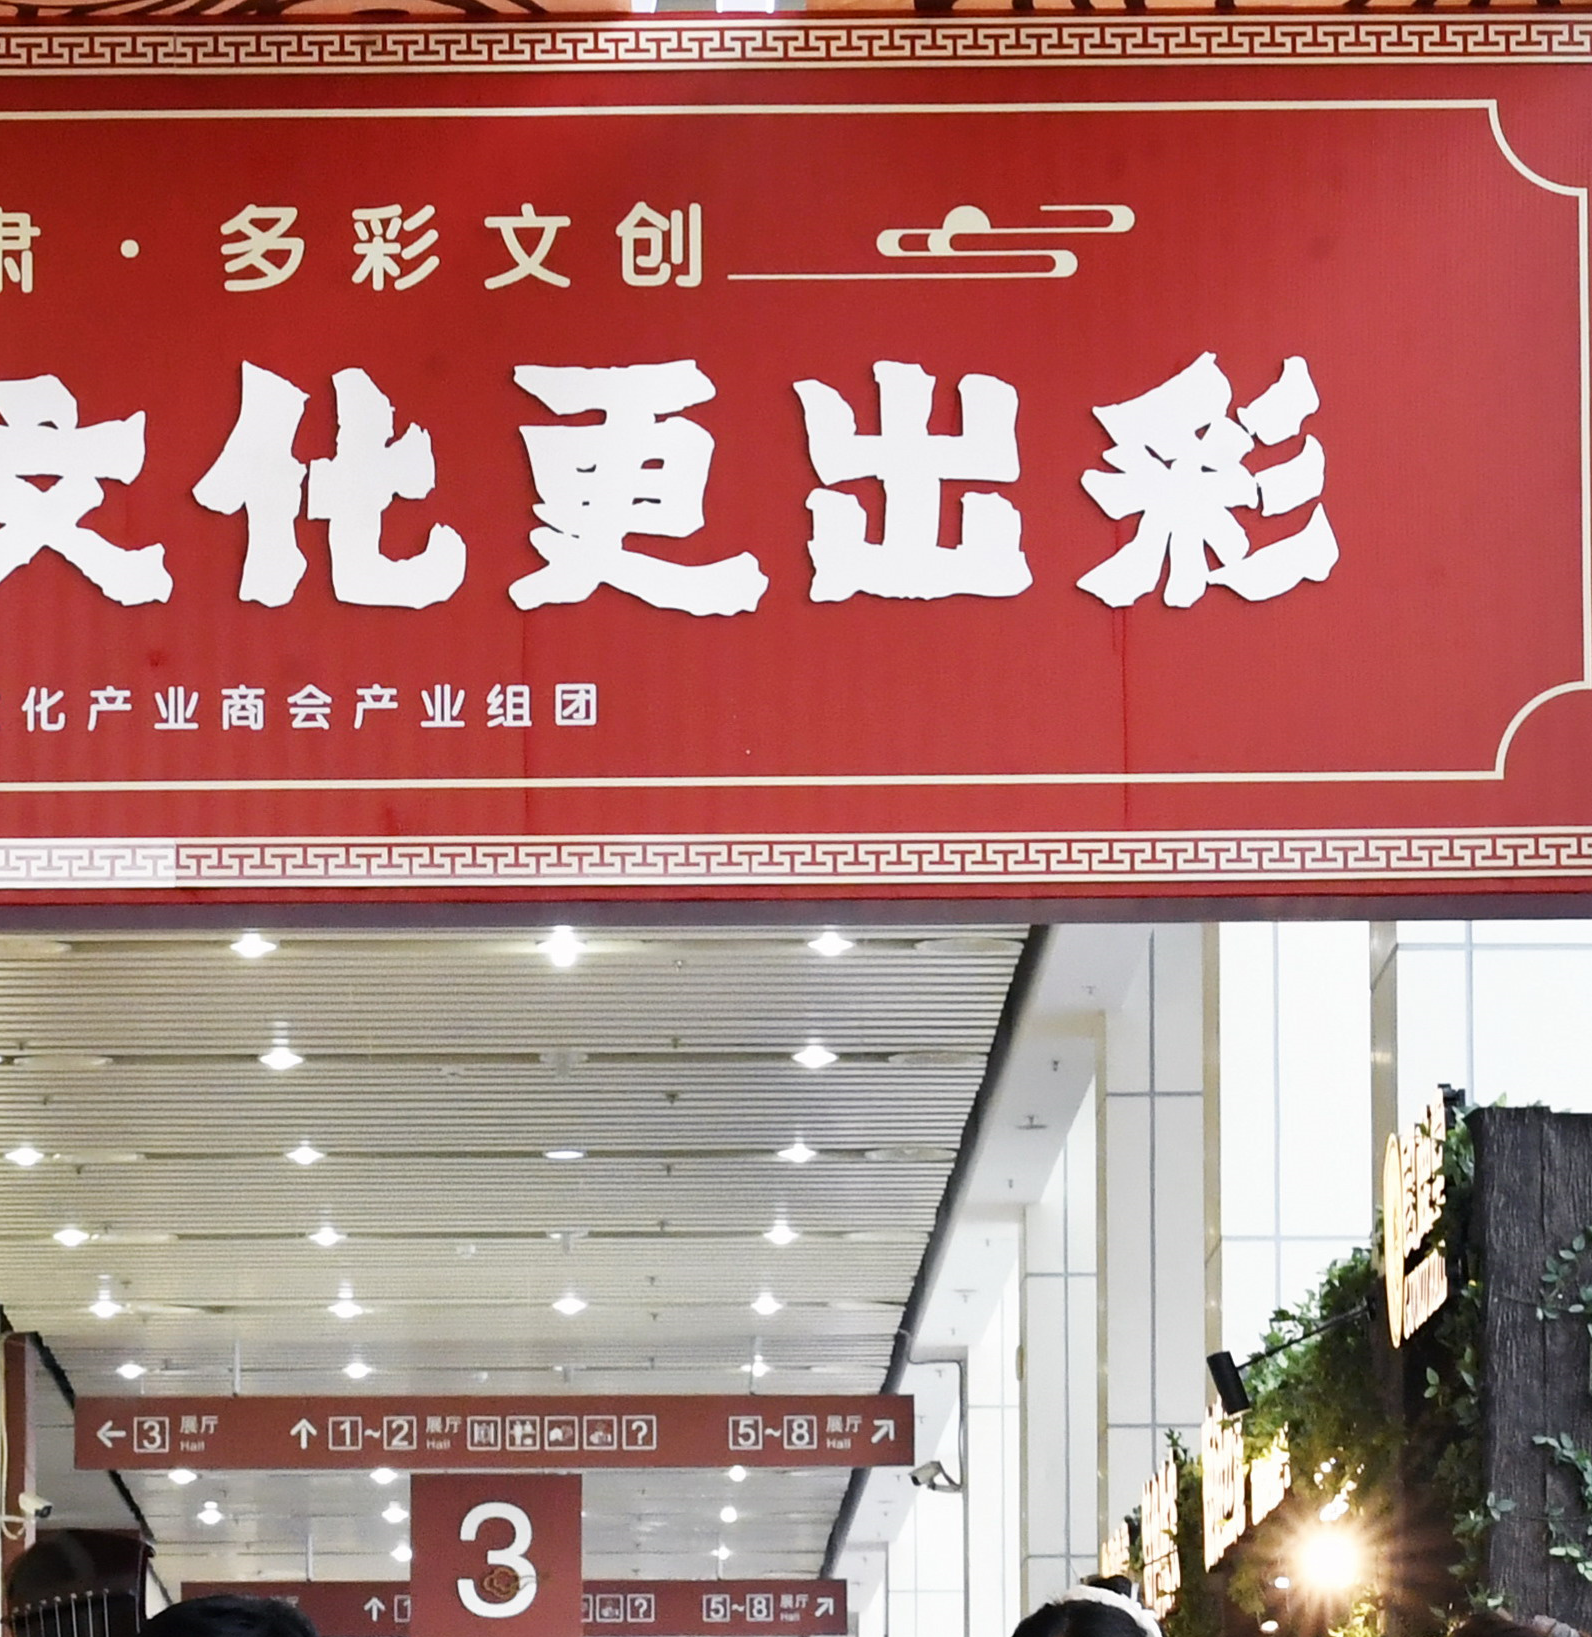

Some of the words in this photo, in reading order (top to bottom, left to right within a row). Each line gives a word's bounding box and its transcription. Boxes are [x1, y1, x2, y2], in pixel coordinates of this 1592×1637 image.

[142, 1420, 162, 1450] 3
[179, 1415, 219, 1435] 展厅
[425, 1415, 462, 1435] 展厅
[825, 1414, 864, 1435] 展厅
[179, 1439, 206, 1452] Hall
[425, 1437, 452, 1451] Hall
[825, 1437, 853, 1451] Hall
[457, 1500, 538, 1620] 3
